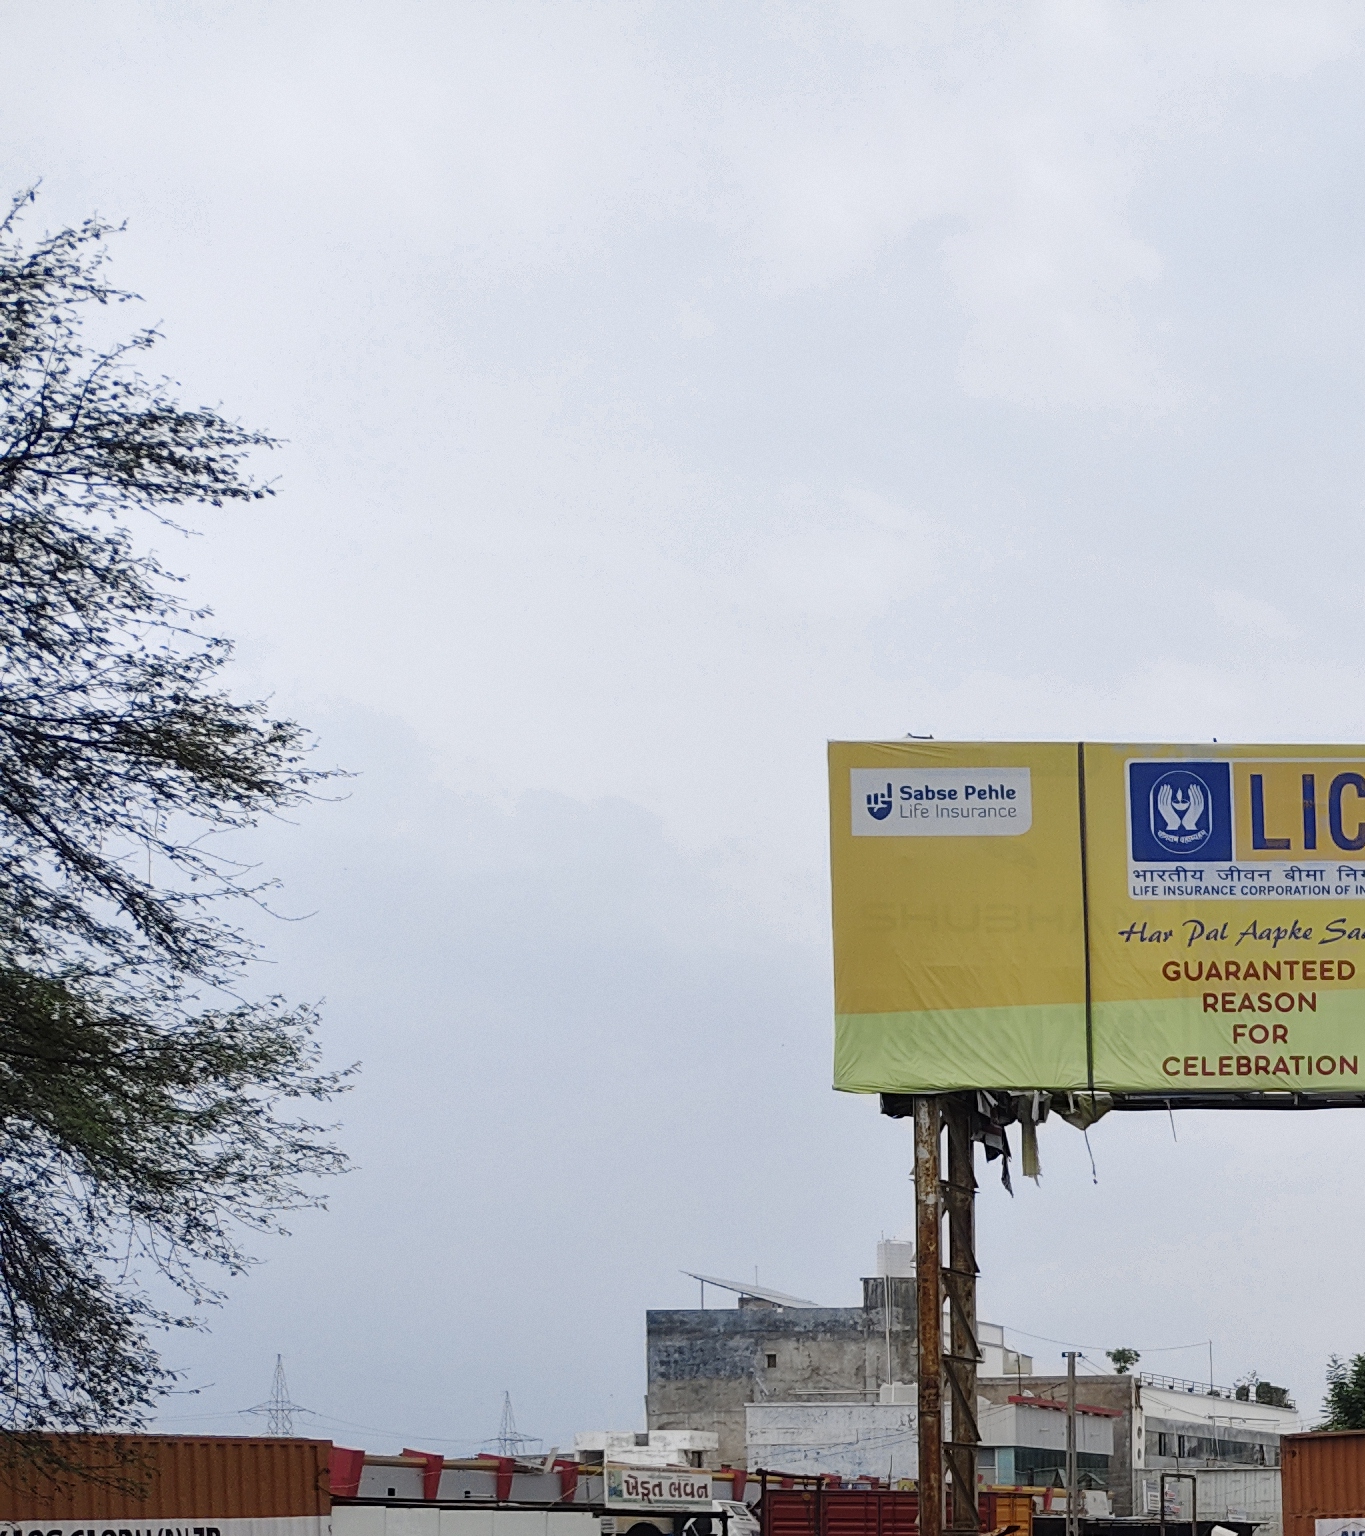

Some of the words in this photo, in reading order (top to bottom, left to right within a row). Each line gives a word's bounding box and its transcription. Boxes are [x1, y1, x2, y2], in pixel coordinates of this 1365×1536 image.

[899, 785, 959, 801] Sabse
[964, 784, 1017, 801] Pehle
[899, 802, 930, 819] Life
[935, 804, 1018, 819] Insurance
[1132, 865, 1205, 882] भारतीय
[1217, 865, 1272, 882] जीवन
[1283, 865, 1326, 882] बीमा
[1132, 885, 1159, 896] LIFE
[1163, 885, 1237, 896] INSURANCE
[1240, 885, 1331, 896] CORPORATION
[1335, 885, 1351, 896] OF
[1118, 921, 1173, 944] Har
[1182, 919, 1228, 948] Pal
[1235, 919, 1312, 948] Aapke
[1162, 960, 1356, 982] GUARANTEED
[1202, 992, 1317, 1013] REASON
[1233, 1024, 1289, 1045] FOR
[1162, 1055, 1358, 1077] CELEBRATION
[624, 1474, 663, 1504] ખેડૂત
[669, 1482, 709, 1499] ભવન
